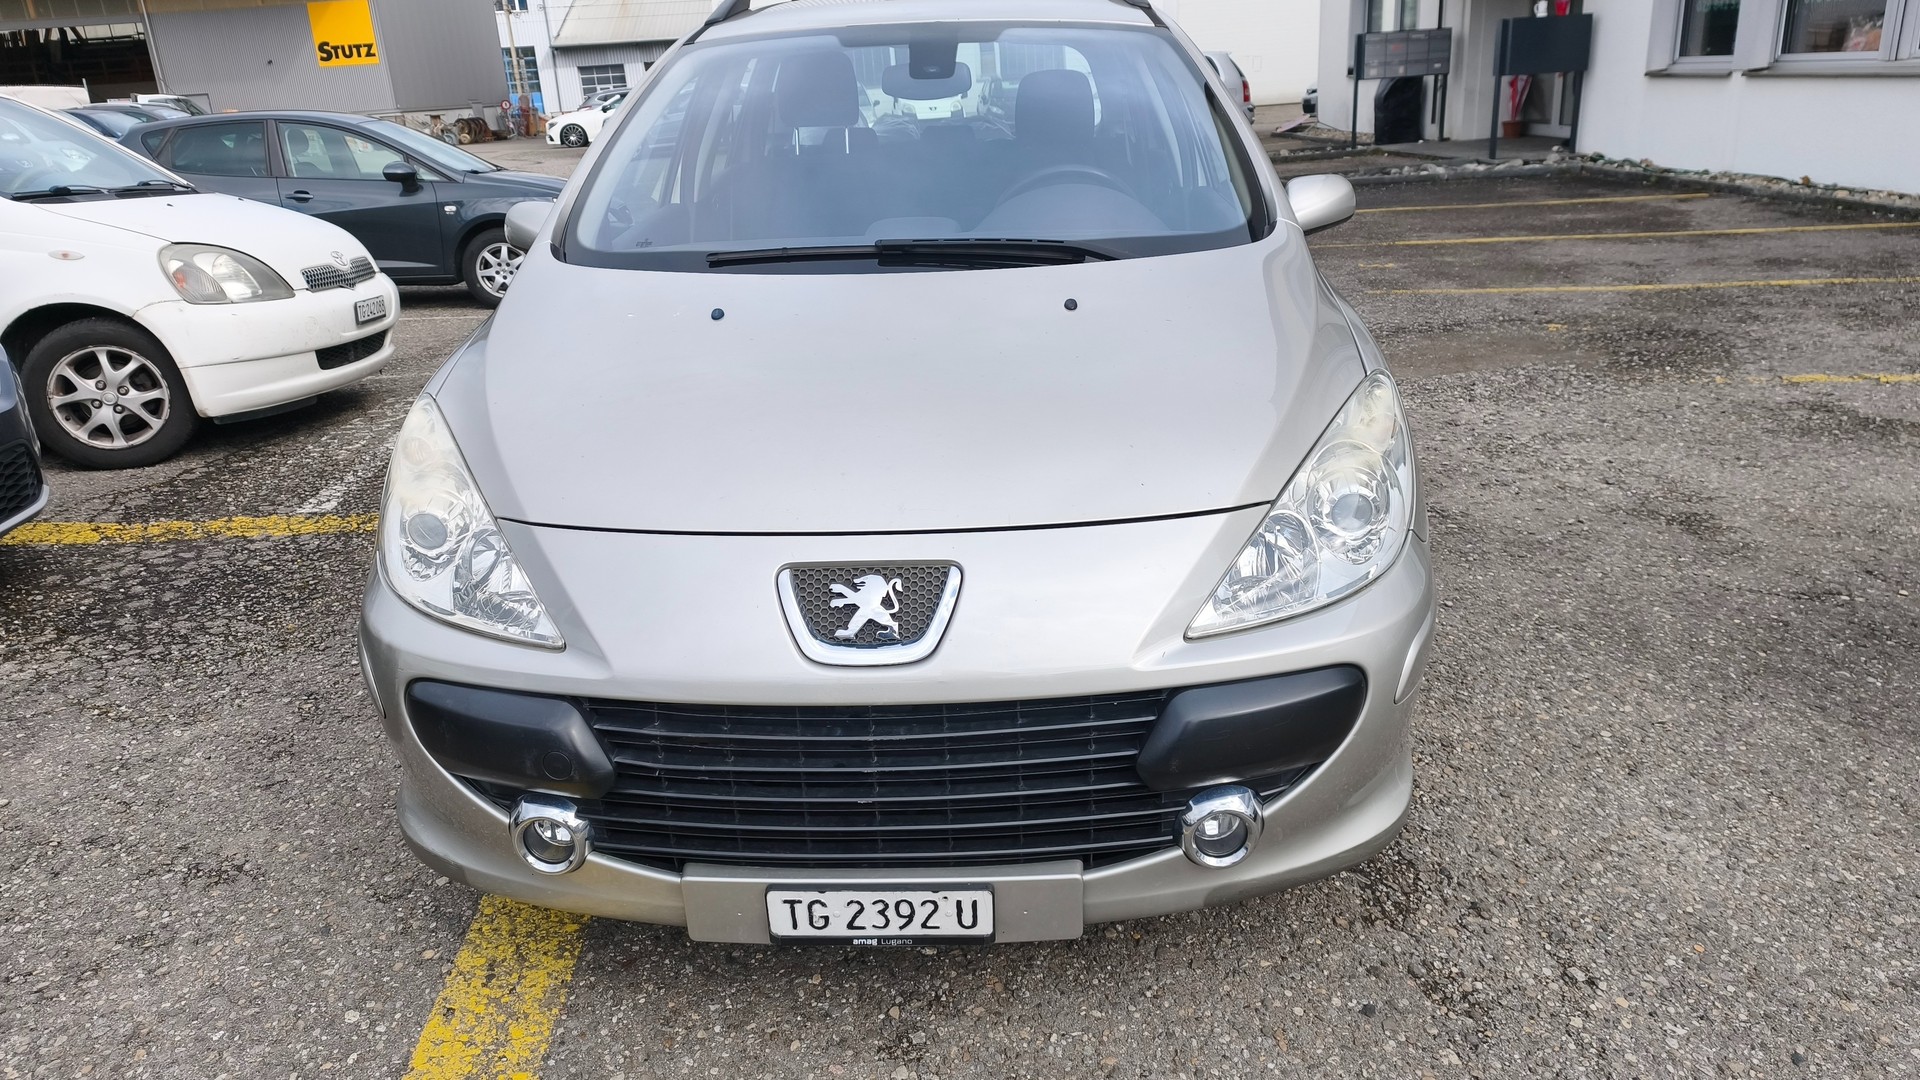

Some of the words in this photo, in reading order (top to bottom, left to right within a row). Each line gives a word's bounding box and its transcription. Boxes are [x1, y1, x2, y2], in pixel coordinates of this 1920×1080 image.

[318, 41, 376, 61] STUTZ
[782, 899, 829, 930] TG
[846, 899, 939, 931] 2392
[956, 899, 978, 930] U
[853, 938, 878, 946] amag
[881, 938, 913, 946] Lugano
